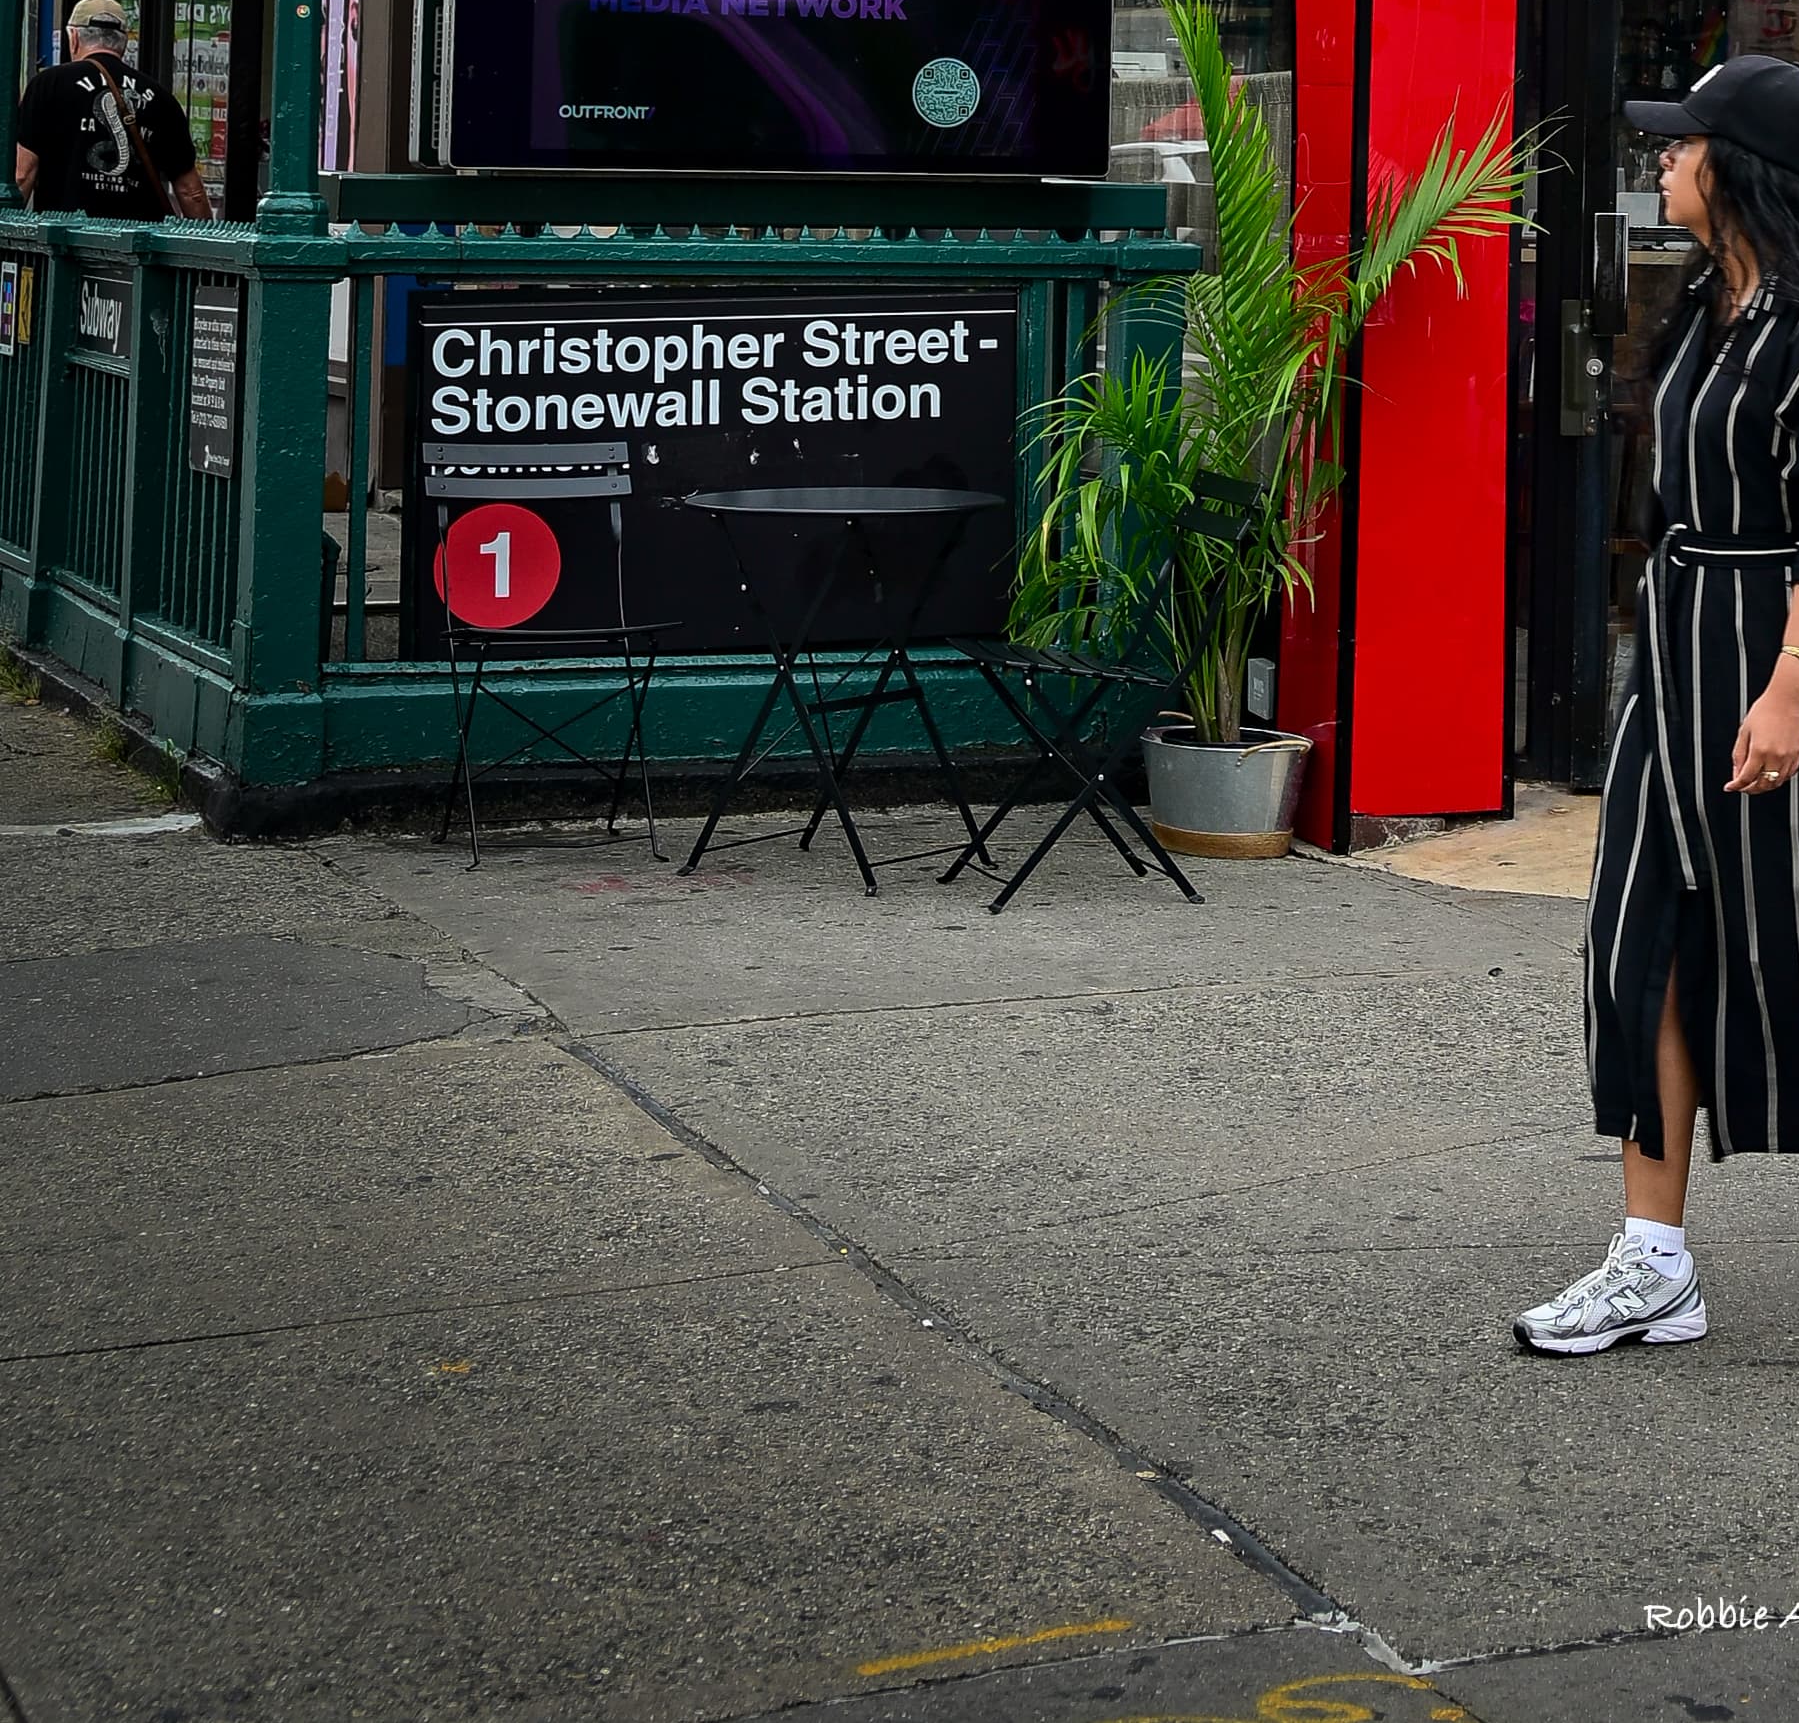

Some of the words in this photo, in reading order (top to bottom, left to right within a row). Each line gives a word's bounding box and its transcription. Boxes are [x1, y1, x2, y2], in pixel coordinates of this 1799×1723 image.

[80, 280, 123, 355] Subway
[431, 325, 785, 384] Christopher
[431, 378, 721, 435] Stonewall
[741, 374, 942, 425] Station
[479, 531, 511, 598] 1
